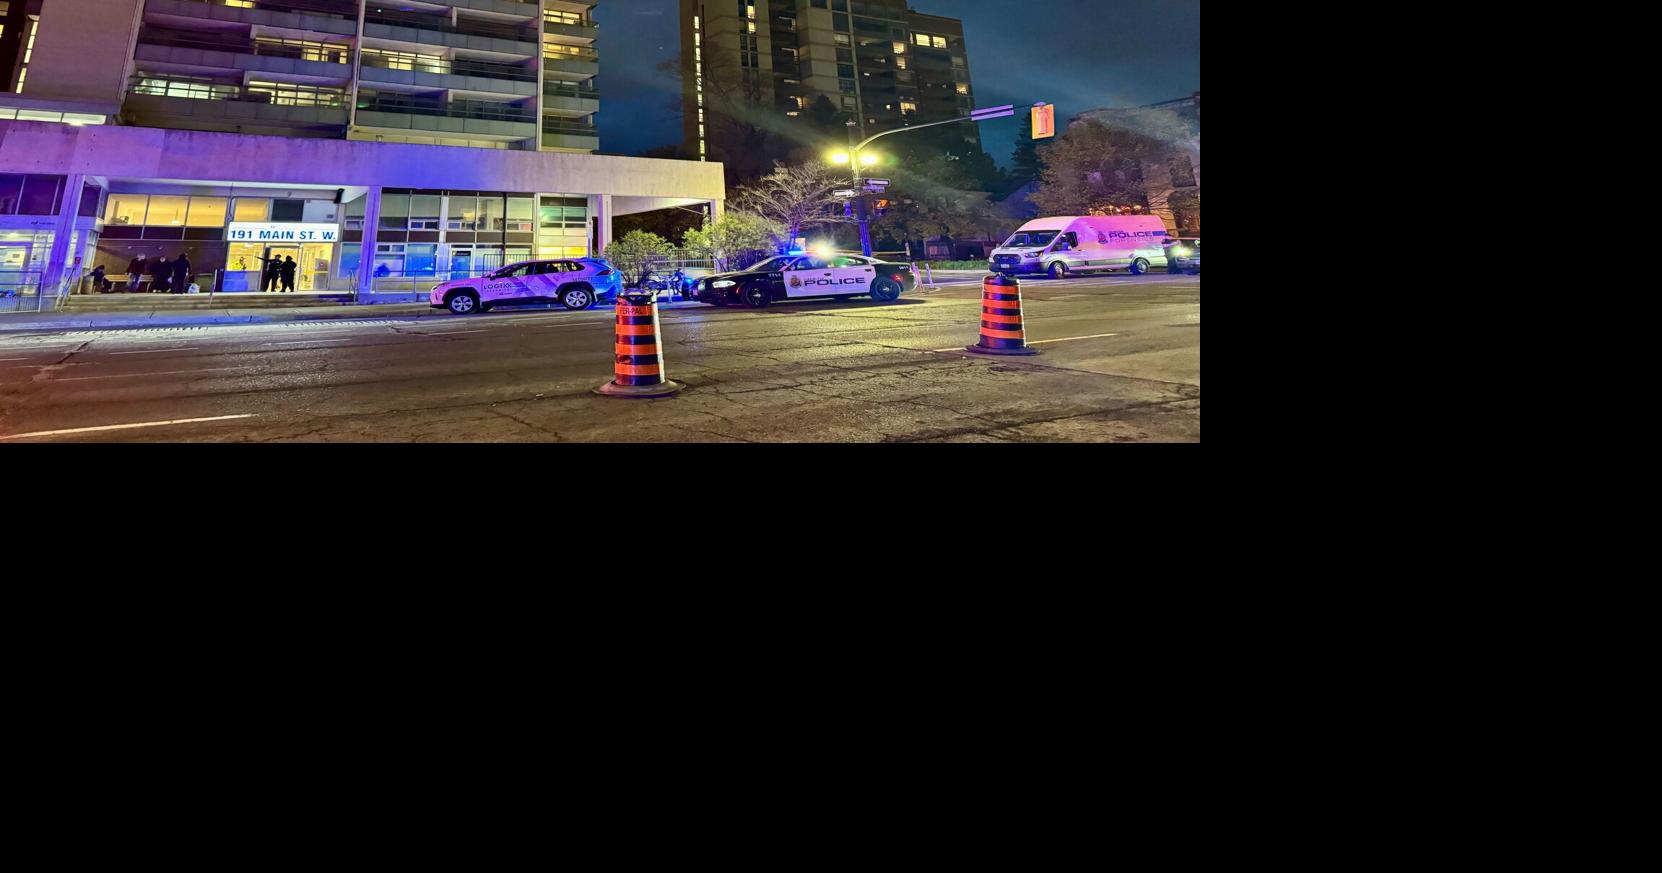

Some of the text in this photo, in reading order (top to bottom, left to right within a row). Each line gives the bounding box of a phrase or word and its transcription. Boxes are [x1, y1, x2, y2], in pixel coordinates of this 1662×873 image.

[231, 230, 336, 240] 191 MAIN ST. W.
[483, 282, 512, 290] LOGIXX
[804, 278, 865, 286] POLICE
